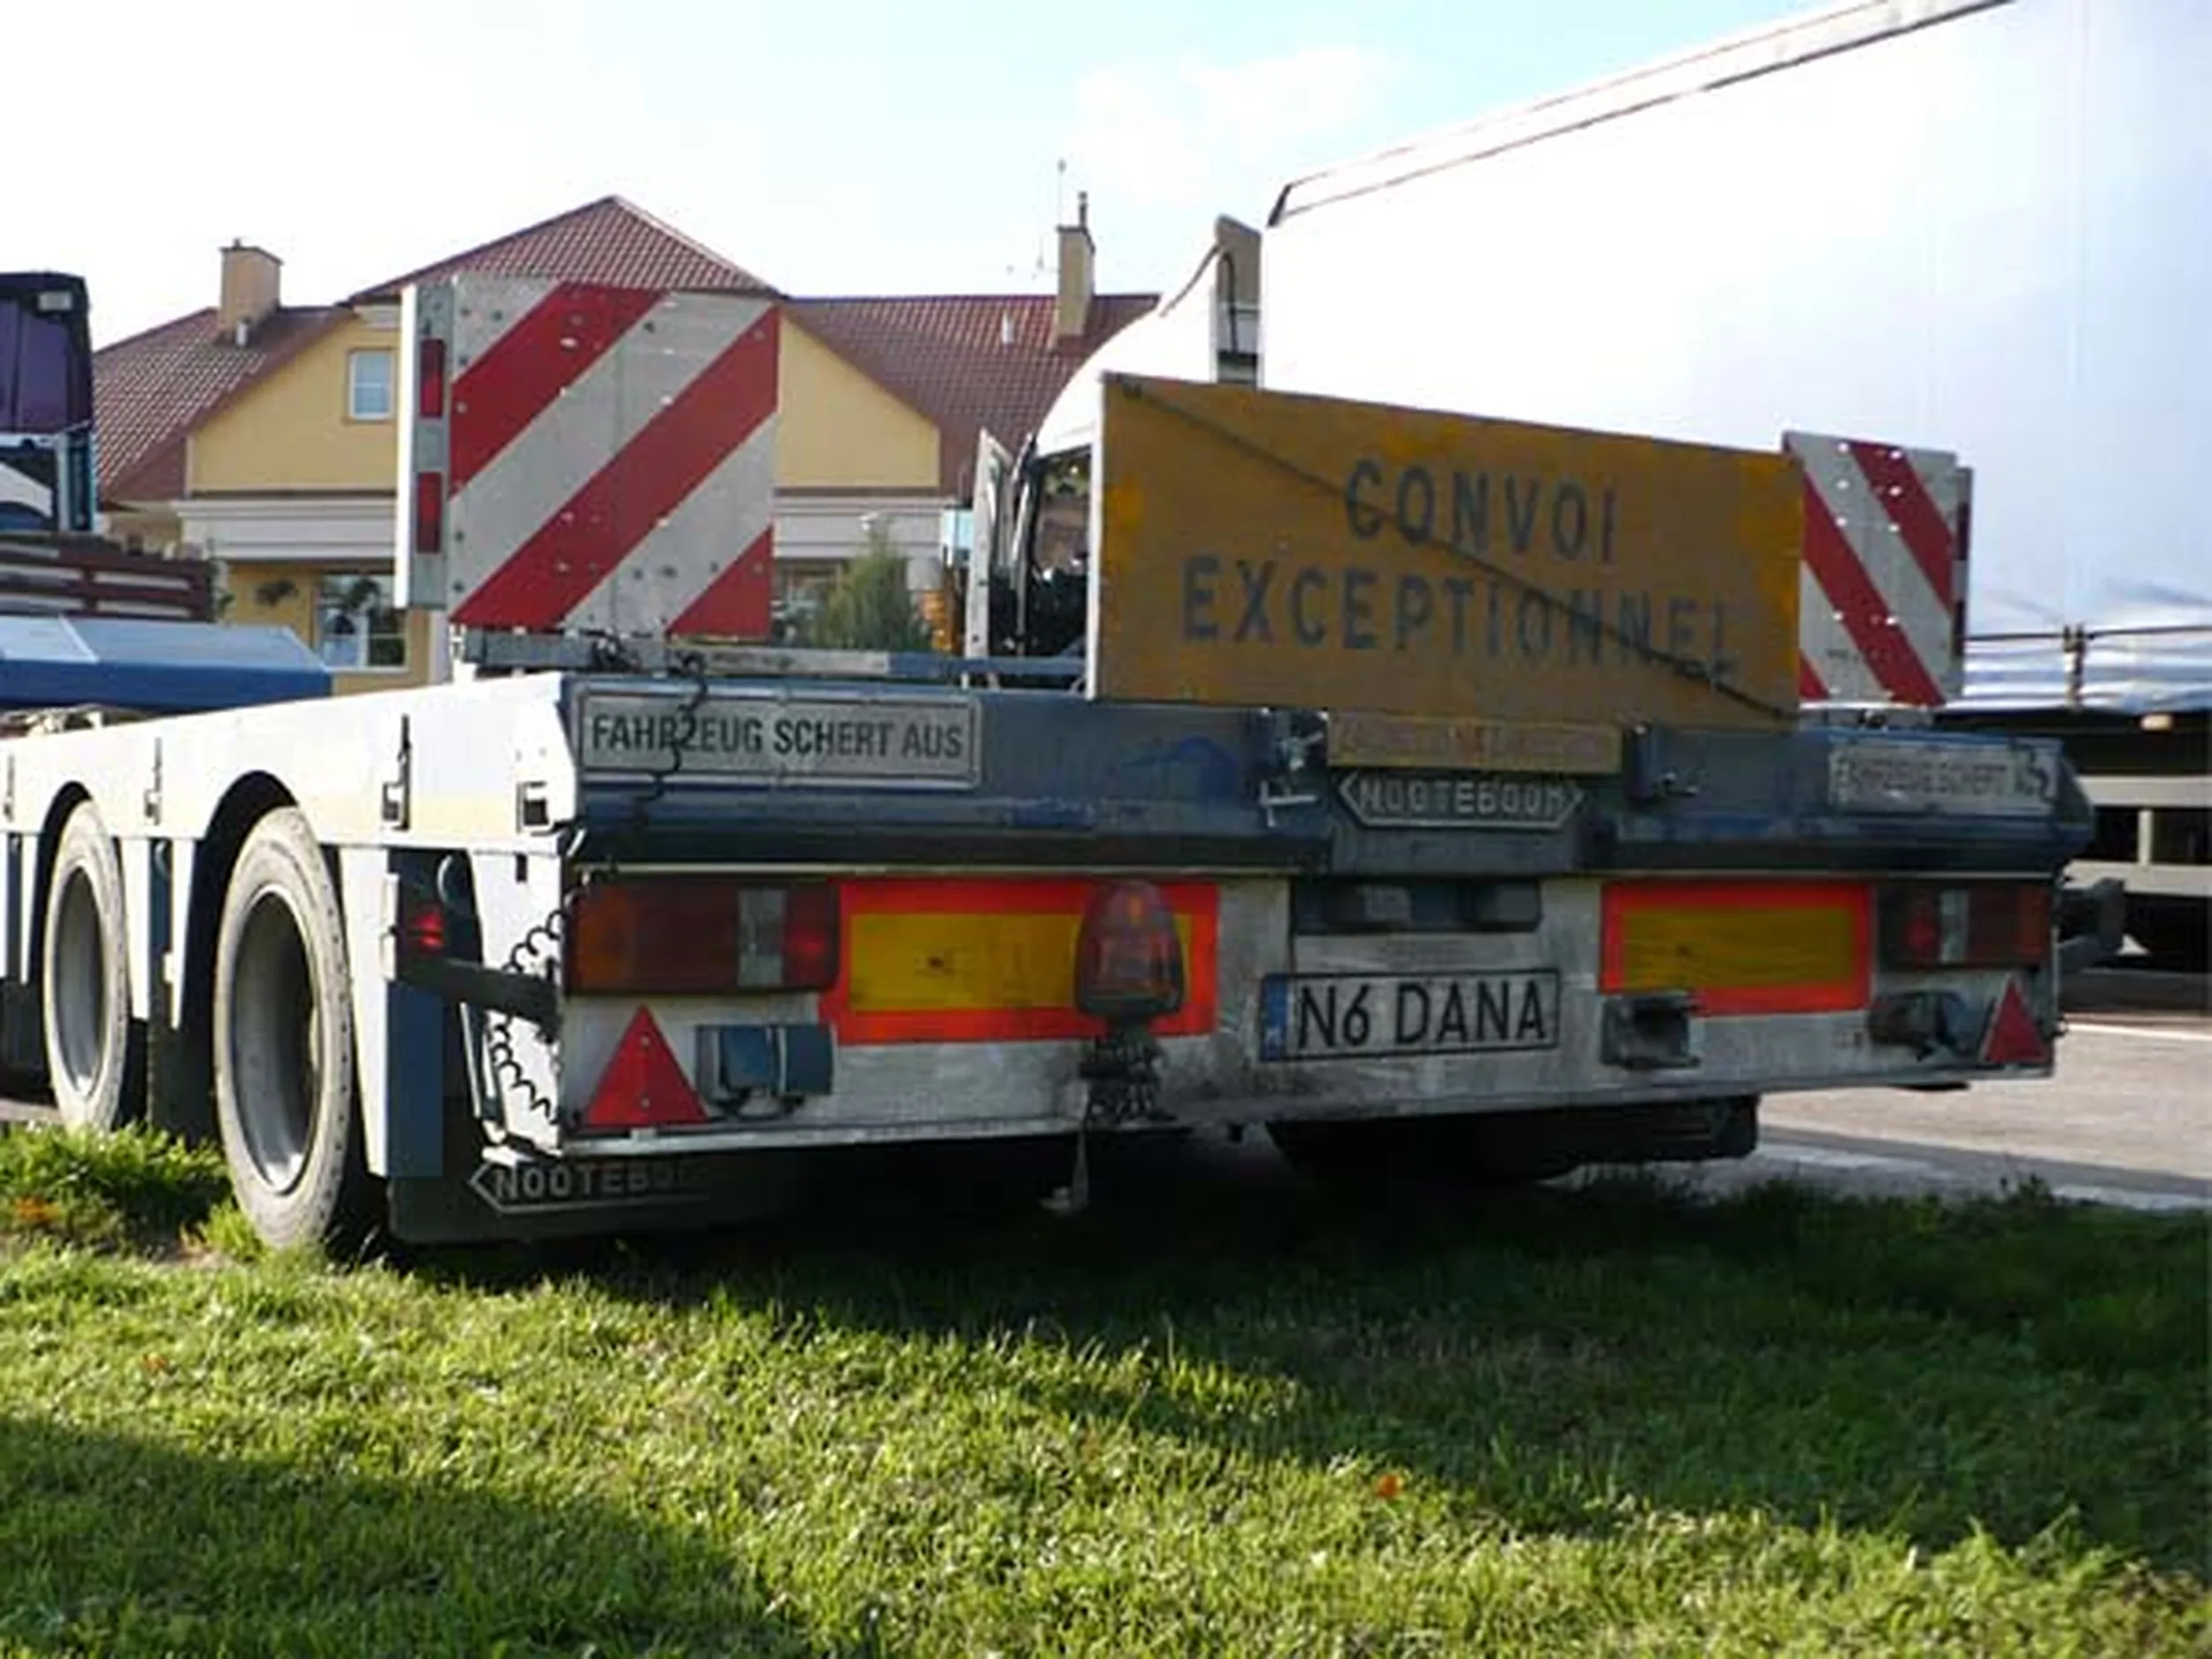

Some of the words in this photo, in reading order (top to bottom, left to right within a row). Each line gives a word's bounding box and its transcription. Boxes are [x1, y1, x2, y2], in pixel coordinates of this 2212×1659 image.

[1344, 458, 1617, 565] CONVOI
[1181, 552, 1740, 680] EXCEPTIONNEL
[591, 713, 762, 756] FAHRZEUG
[773, 718, 895, 758] SCHERT
[901, 723, 964, 759] AUS
[1297, 983, 1371, 1049] N6
[1393, 979, 1548, 1046] DANA
